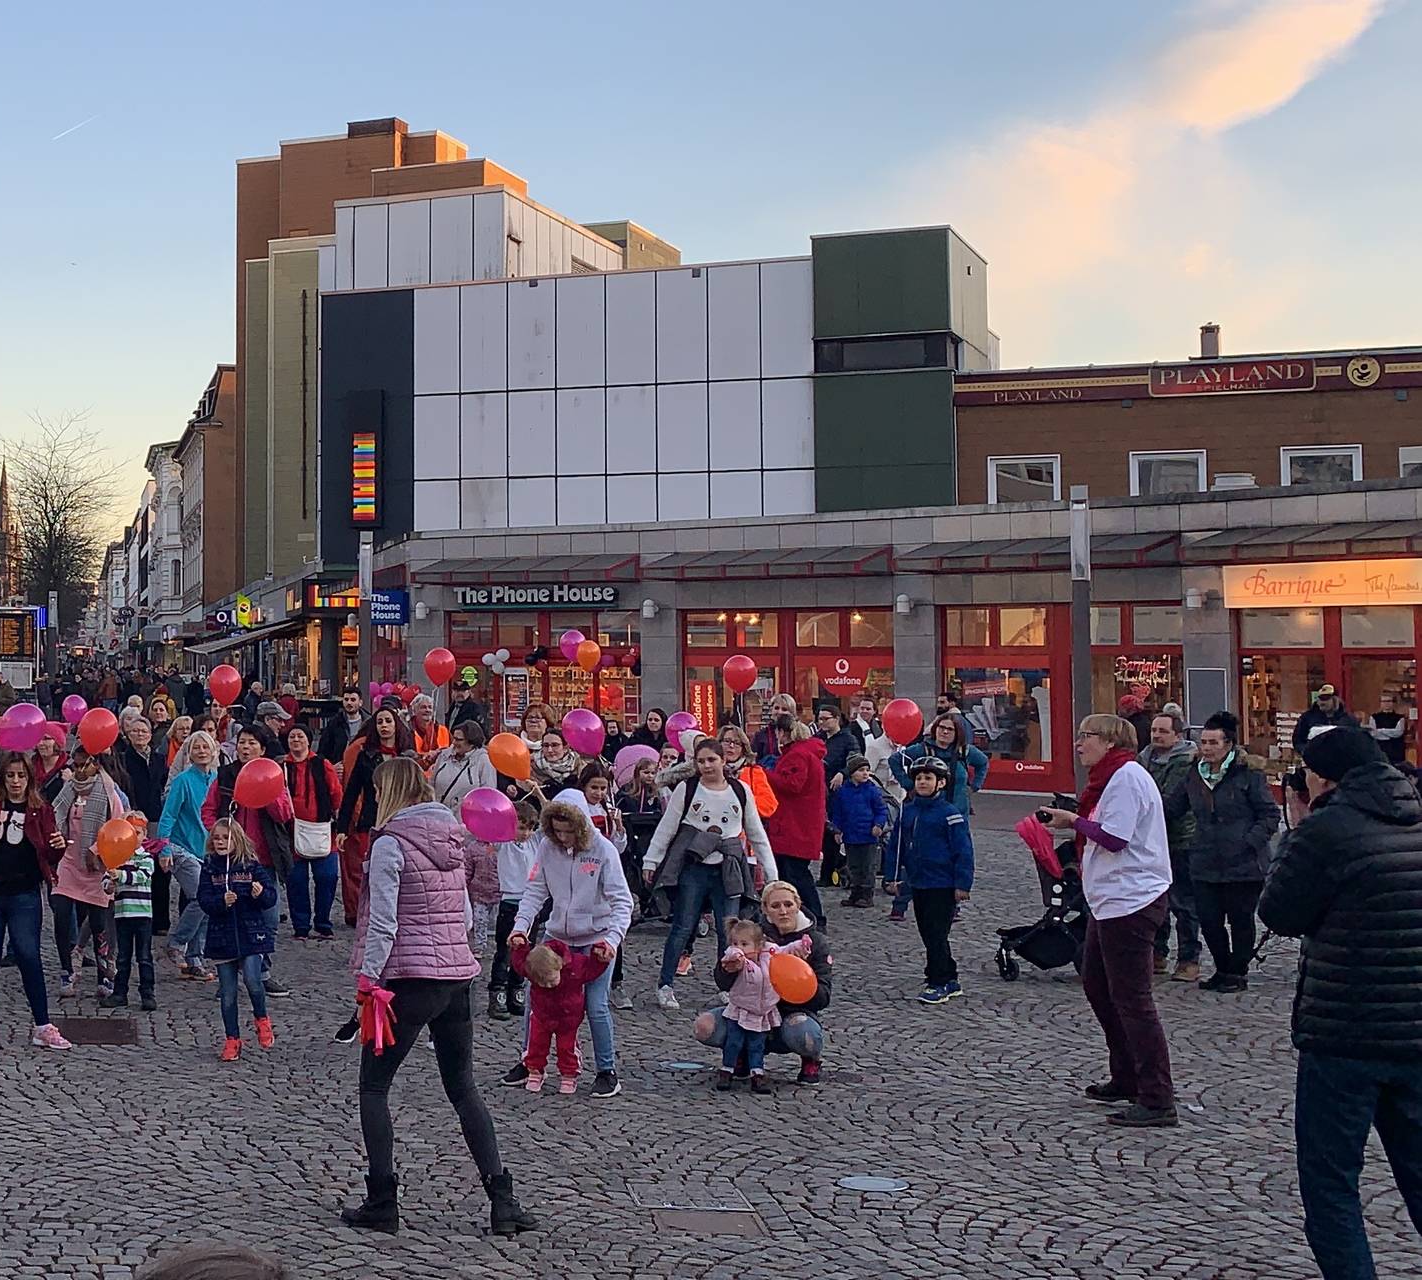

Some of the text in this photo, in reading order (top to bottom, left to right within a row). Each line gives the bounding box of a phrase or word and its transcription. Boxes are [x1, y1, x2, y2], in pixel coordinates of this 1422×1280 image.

[1159, 363, 1305, 385] PLAYLAND
[1196, 382, 1267, 392] SPIELHALLE
[994, 389, 1082, 402] PLAYLAND
[1243, 568, 1347, 603] Barrique
[371, 594, 389, 602] The
[454, 584, 615, 603] The Phone House
[371, 602, 401, 611] Phone
[371, 611, 401, 619] House
[824, 676, 862, 685] vodafone
[693, 684, 702, 730] odafone
